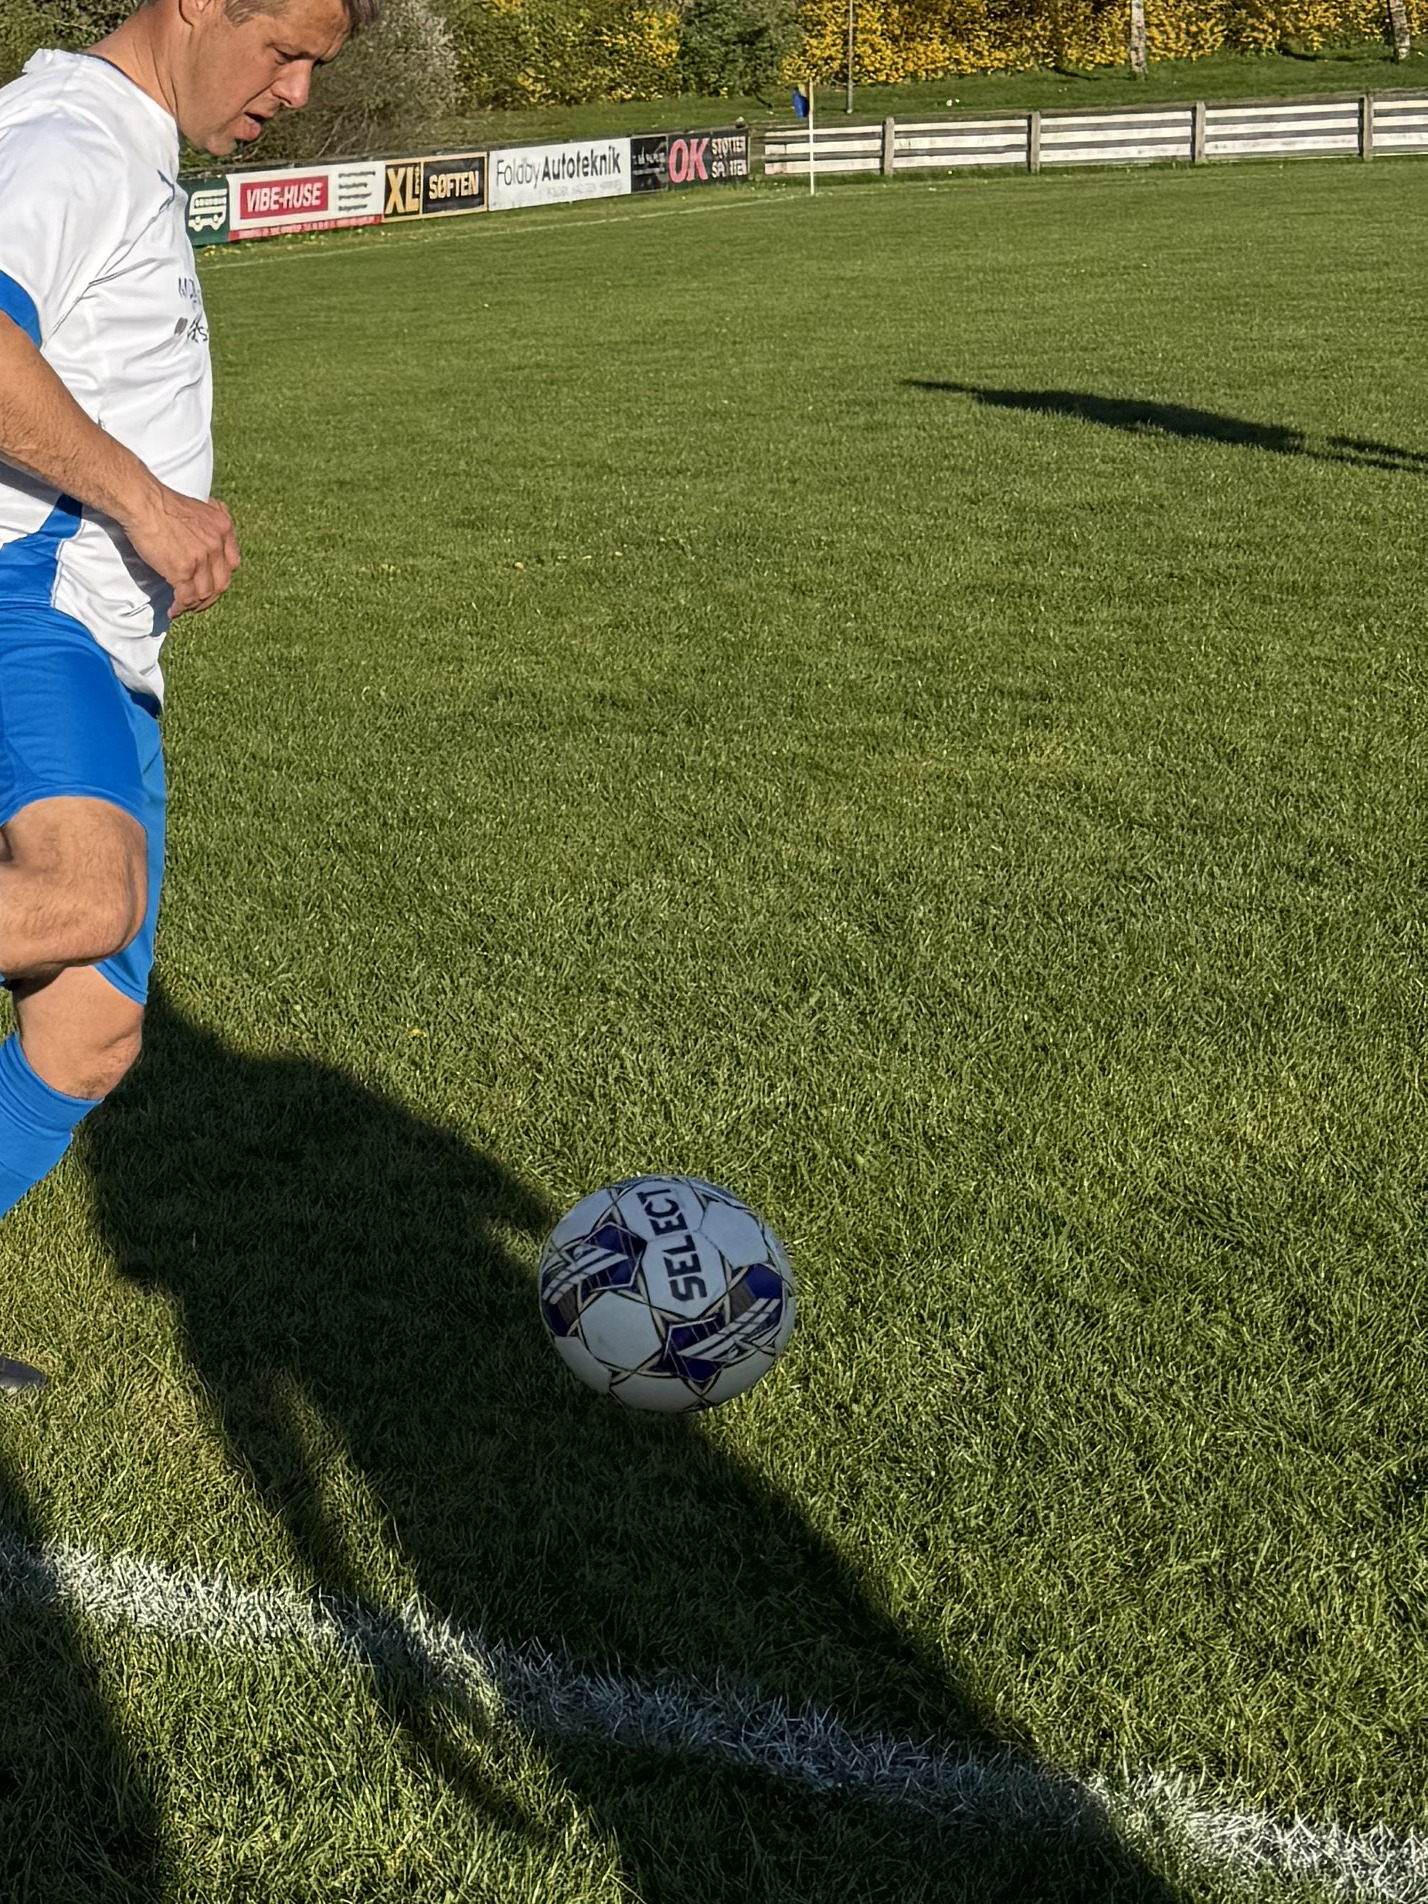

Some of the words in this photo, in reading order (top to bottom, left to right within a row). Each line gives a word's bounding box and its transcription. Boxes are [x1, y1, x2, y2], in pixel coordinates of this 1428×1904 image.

[497, 157, 540, 189] Foldby
[541, 145, 621, 182] Autoteknik
[669, 138, 710, 183] OK
[245, 182, 323, 213] VIBE-HUSE
[385, 166, 419, 214] XL
[429, 170, 479, 200] SØFTEN
[636, 1187, 708, 1302] SELECT
